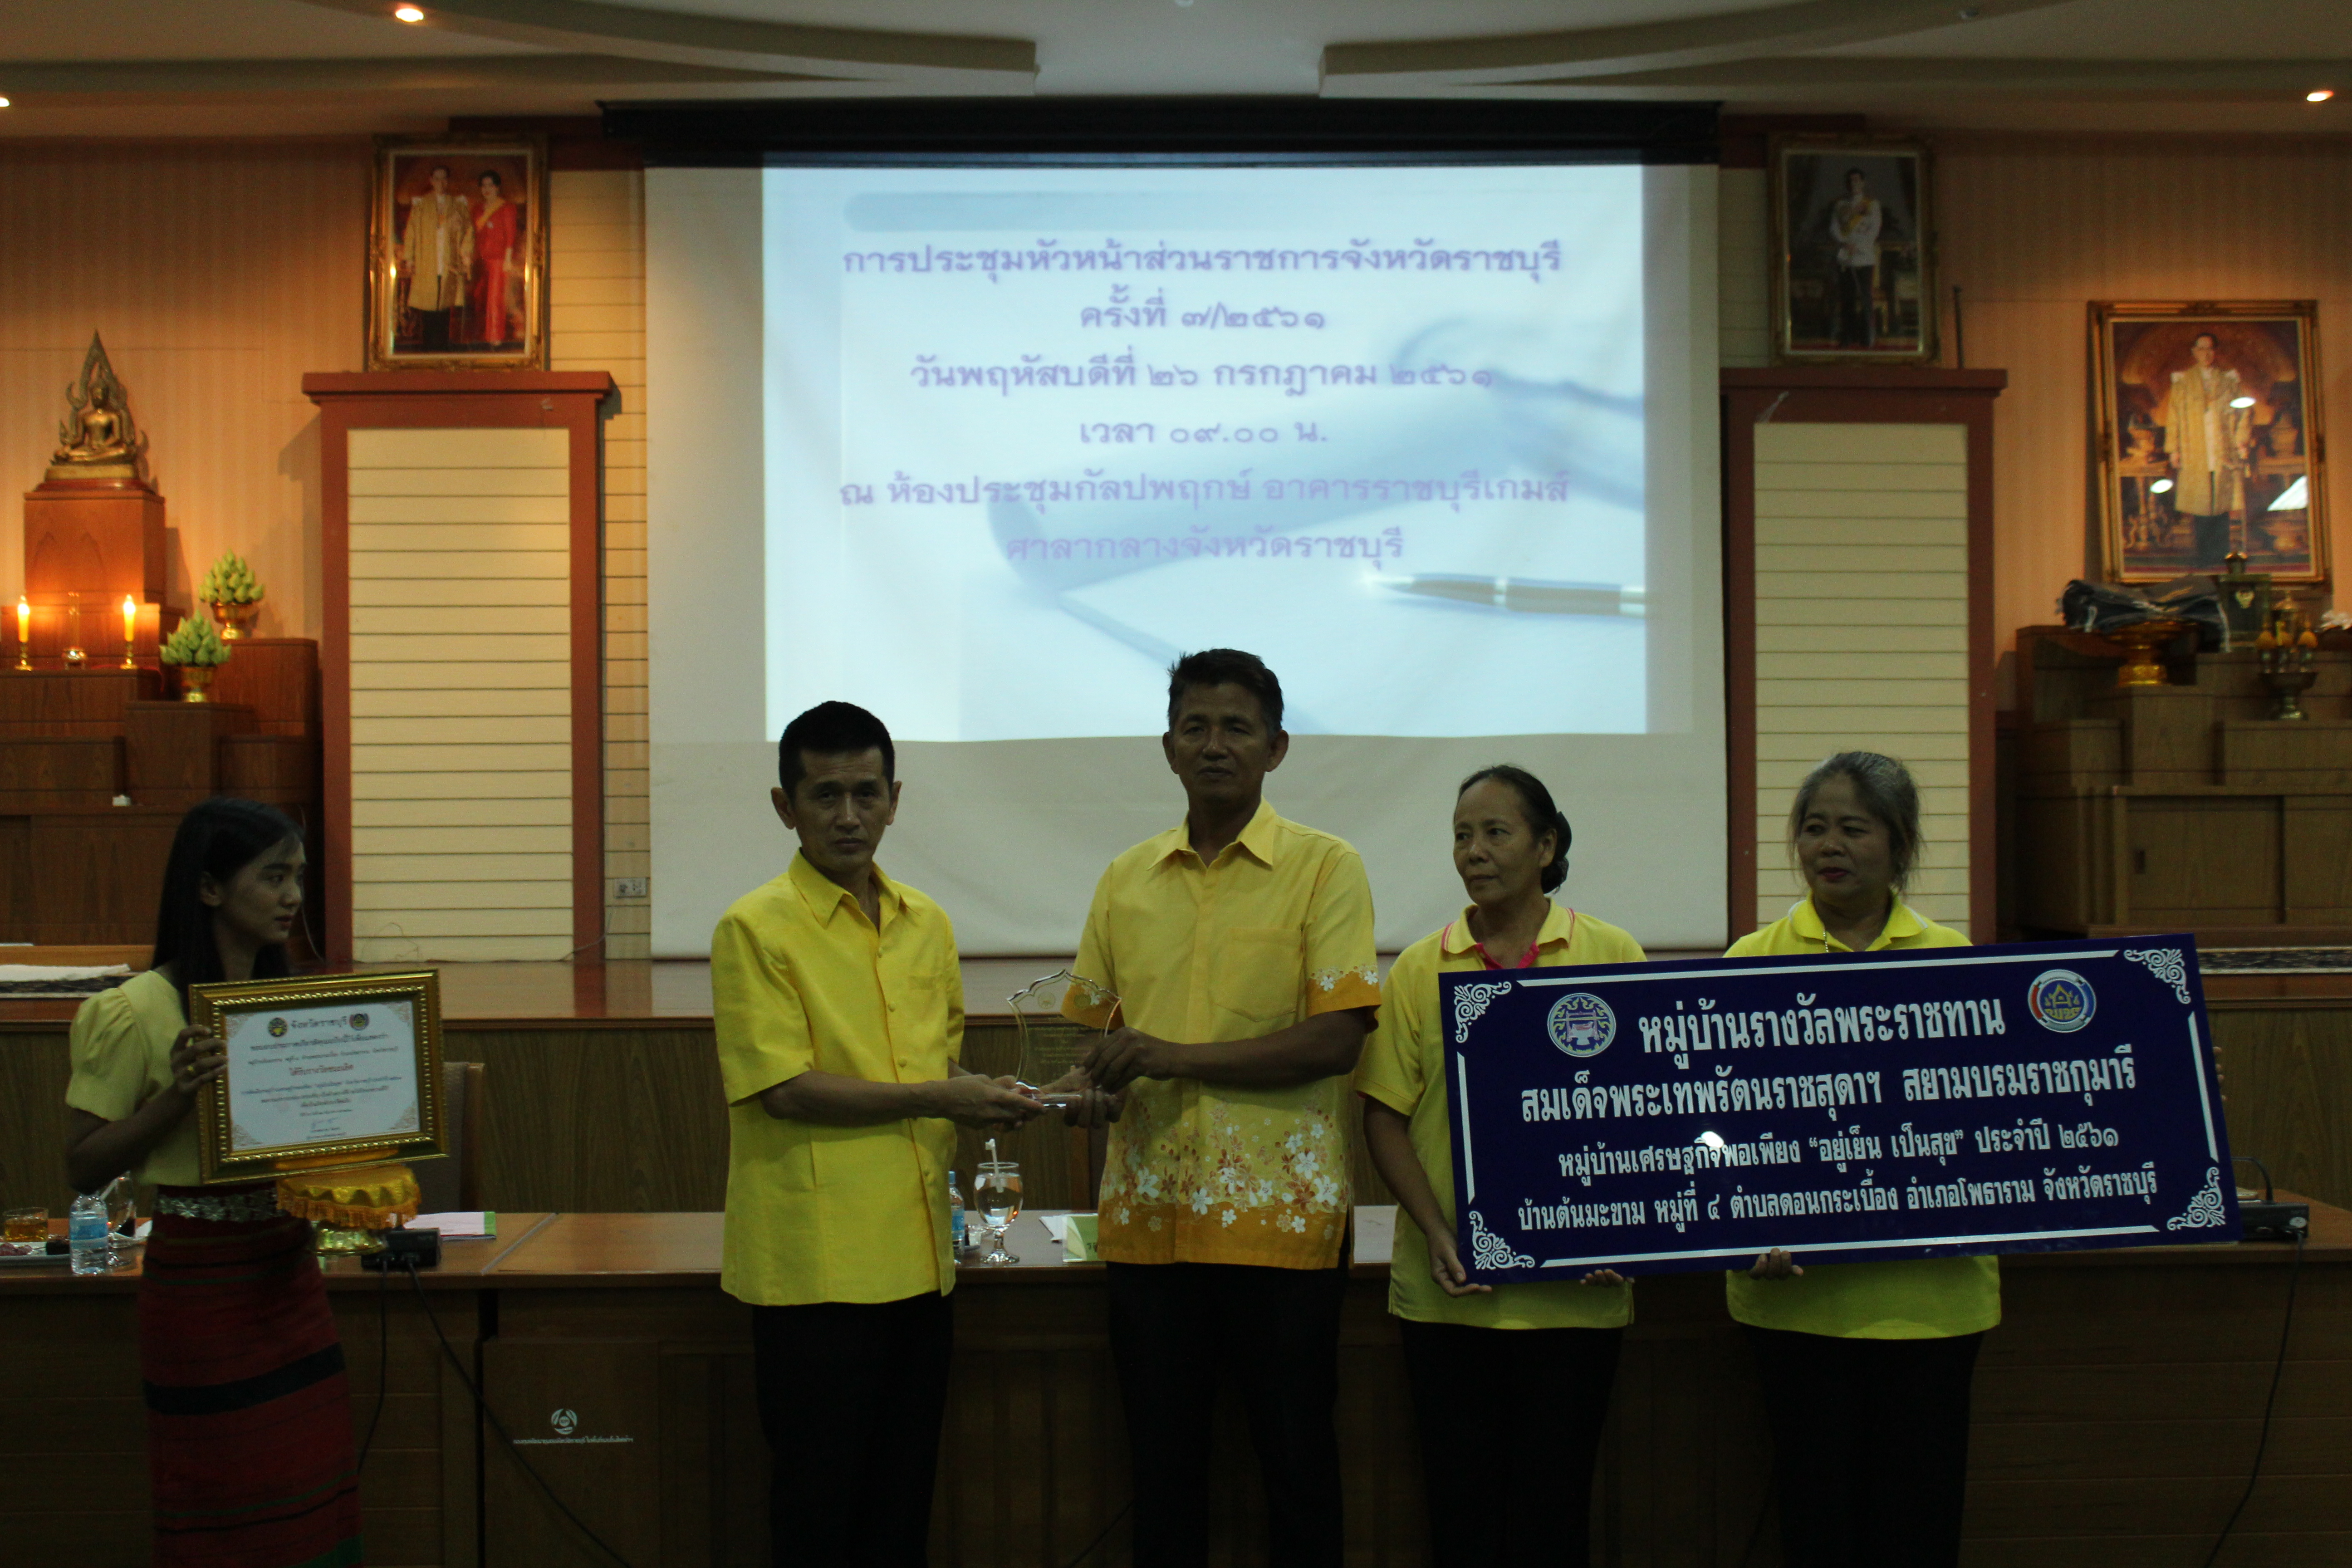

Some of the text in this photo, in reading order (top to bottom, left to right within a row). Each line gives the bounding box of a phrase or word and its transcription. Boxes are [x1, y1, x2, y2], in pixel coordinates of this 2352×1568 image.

[843, 239, 1561, 283] การประชุมหัวหน้าส่วนราชการจังหวัดราชบุรี
[1081, 284, 1327, 330] ครั้งที่ ๗/๒๕๖๑
[911, 346, 1493, 396] วันพฤหัสบดีที่ ๒๖ กรกฎาคม ๒๕๖๑
[1080, 422, 1328, 444] เวลา ๐๙.๐๐ น.
[839, 468, 1569, 513] ณ ห้องประชุมกัลปพฤกษ์ อาคารราชบุรีเกมส์
[1006, 526, 1403, 570] ศาลากลางจังหวัดราชบุรี
[1639, 993, 2005, 1069] หมู่บ้านรางวัลพระราชทาน
[1522, 1044, 2135, 1122] สมเด็จพระเทพรัตนราชสุดาฯ สยามบรมราชกุมารี
[1558, 1132, 1801, 1187] หมู่บ้านเศรษฐกิจพอเพียง
[1975, 1118, 2050, 1152] ประจำปี
[2058, 1122, 2118, 1148] ๒๕๖๑
[1518, 1196, 1645, 1230] บ้านต้นมะขาม
[1654, 1181, 1698, 1233] หมู่ที่
[1730, 1169, 1898, 1218] ตำบลดอนกระเบื้อง
[1906, 1176, 2035, 1209] อำเภอโพธาราม
[2043, 1161, 2157, 1204] จังหวัดราชบุรี
